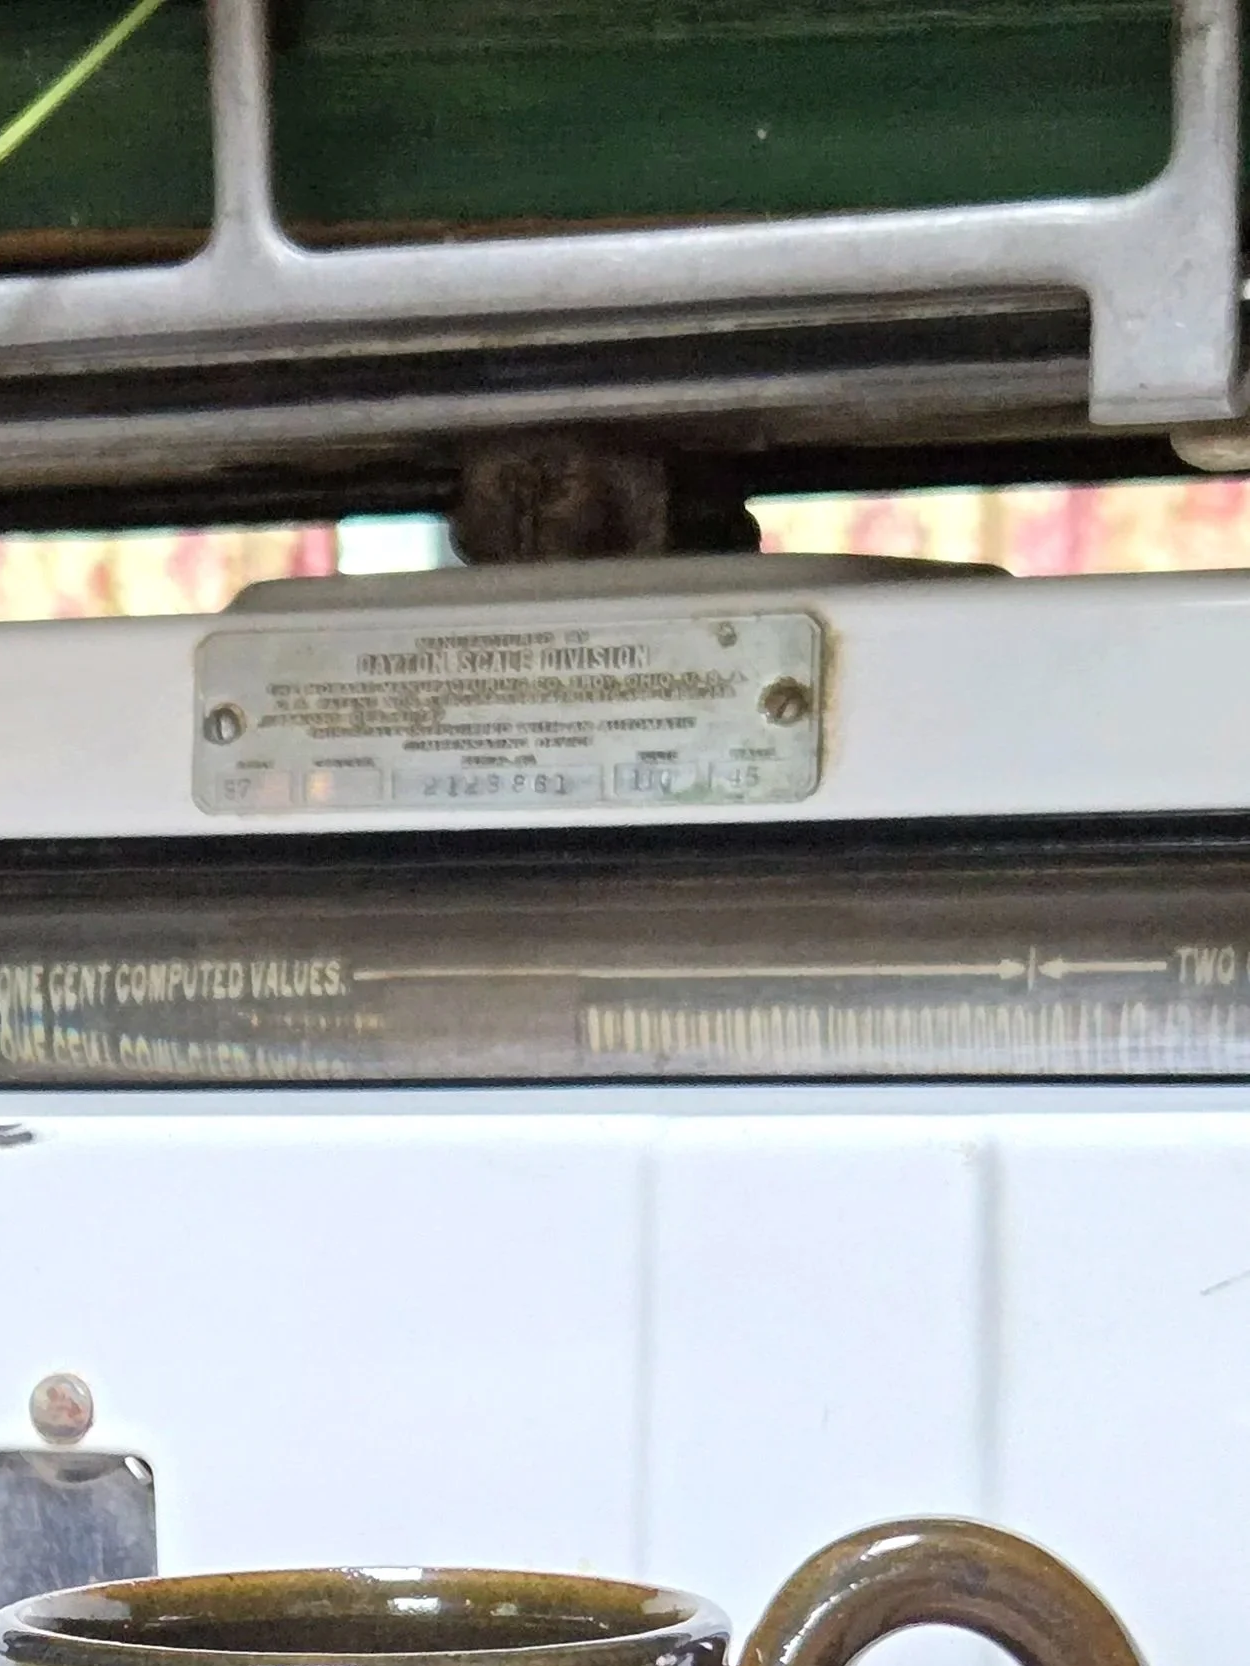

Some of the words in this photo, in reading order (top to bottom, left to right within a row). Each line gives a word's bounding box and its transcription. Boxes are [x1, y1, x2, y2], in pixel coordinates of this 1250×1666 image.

[357, 651, 450, 676] DAYTON
[457, 649, 533, 673] SCALE
[540, 645, 650, 671] DIVISION
[50, 962, 112, 1009] CENT
[115, 958, 245, 1004] COMPUTED
[1174, 945, 1235, 985] TWO
